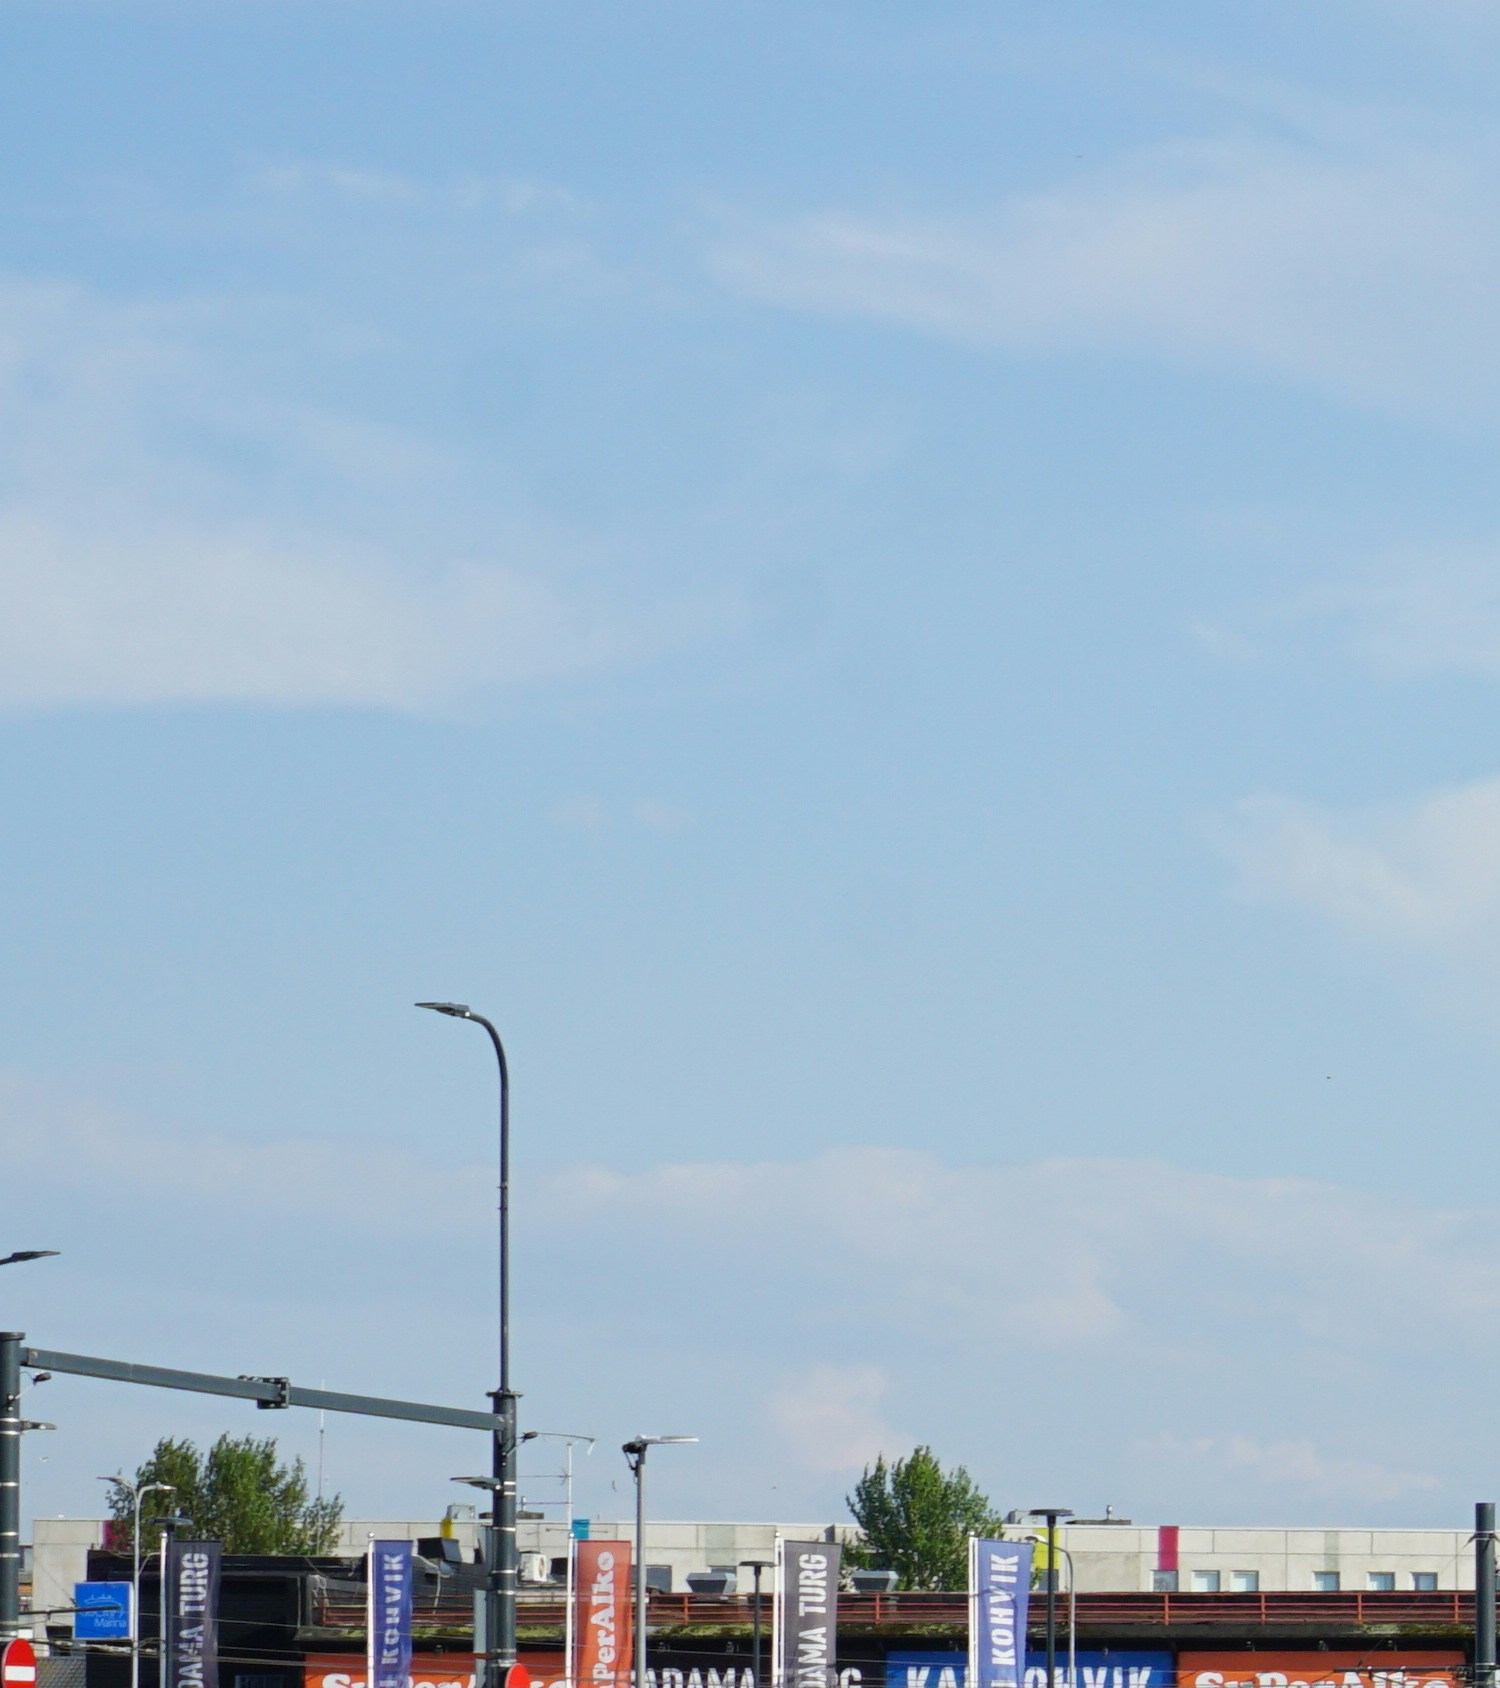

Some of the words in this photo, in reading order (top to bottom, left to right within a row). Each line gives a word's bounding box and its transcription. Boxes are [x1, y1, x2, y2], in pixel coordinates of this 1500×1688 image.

[180, 1552, 209, 1616] TURG
[798, 1553, 828, 1617] TURG
[990, 1553, 1020, 1666] KOHVIK
